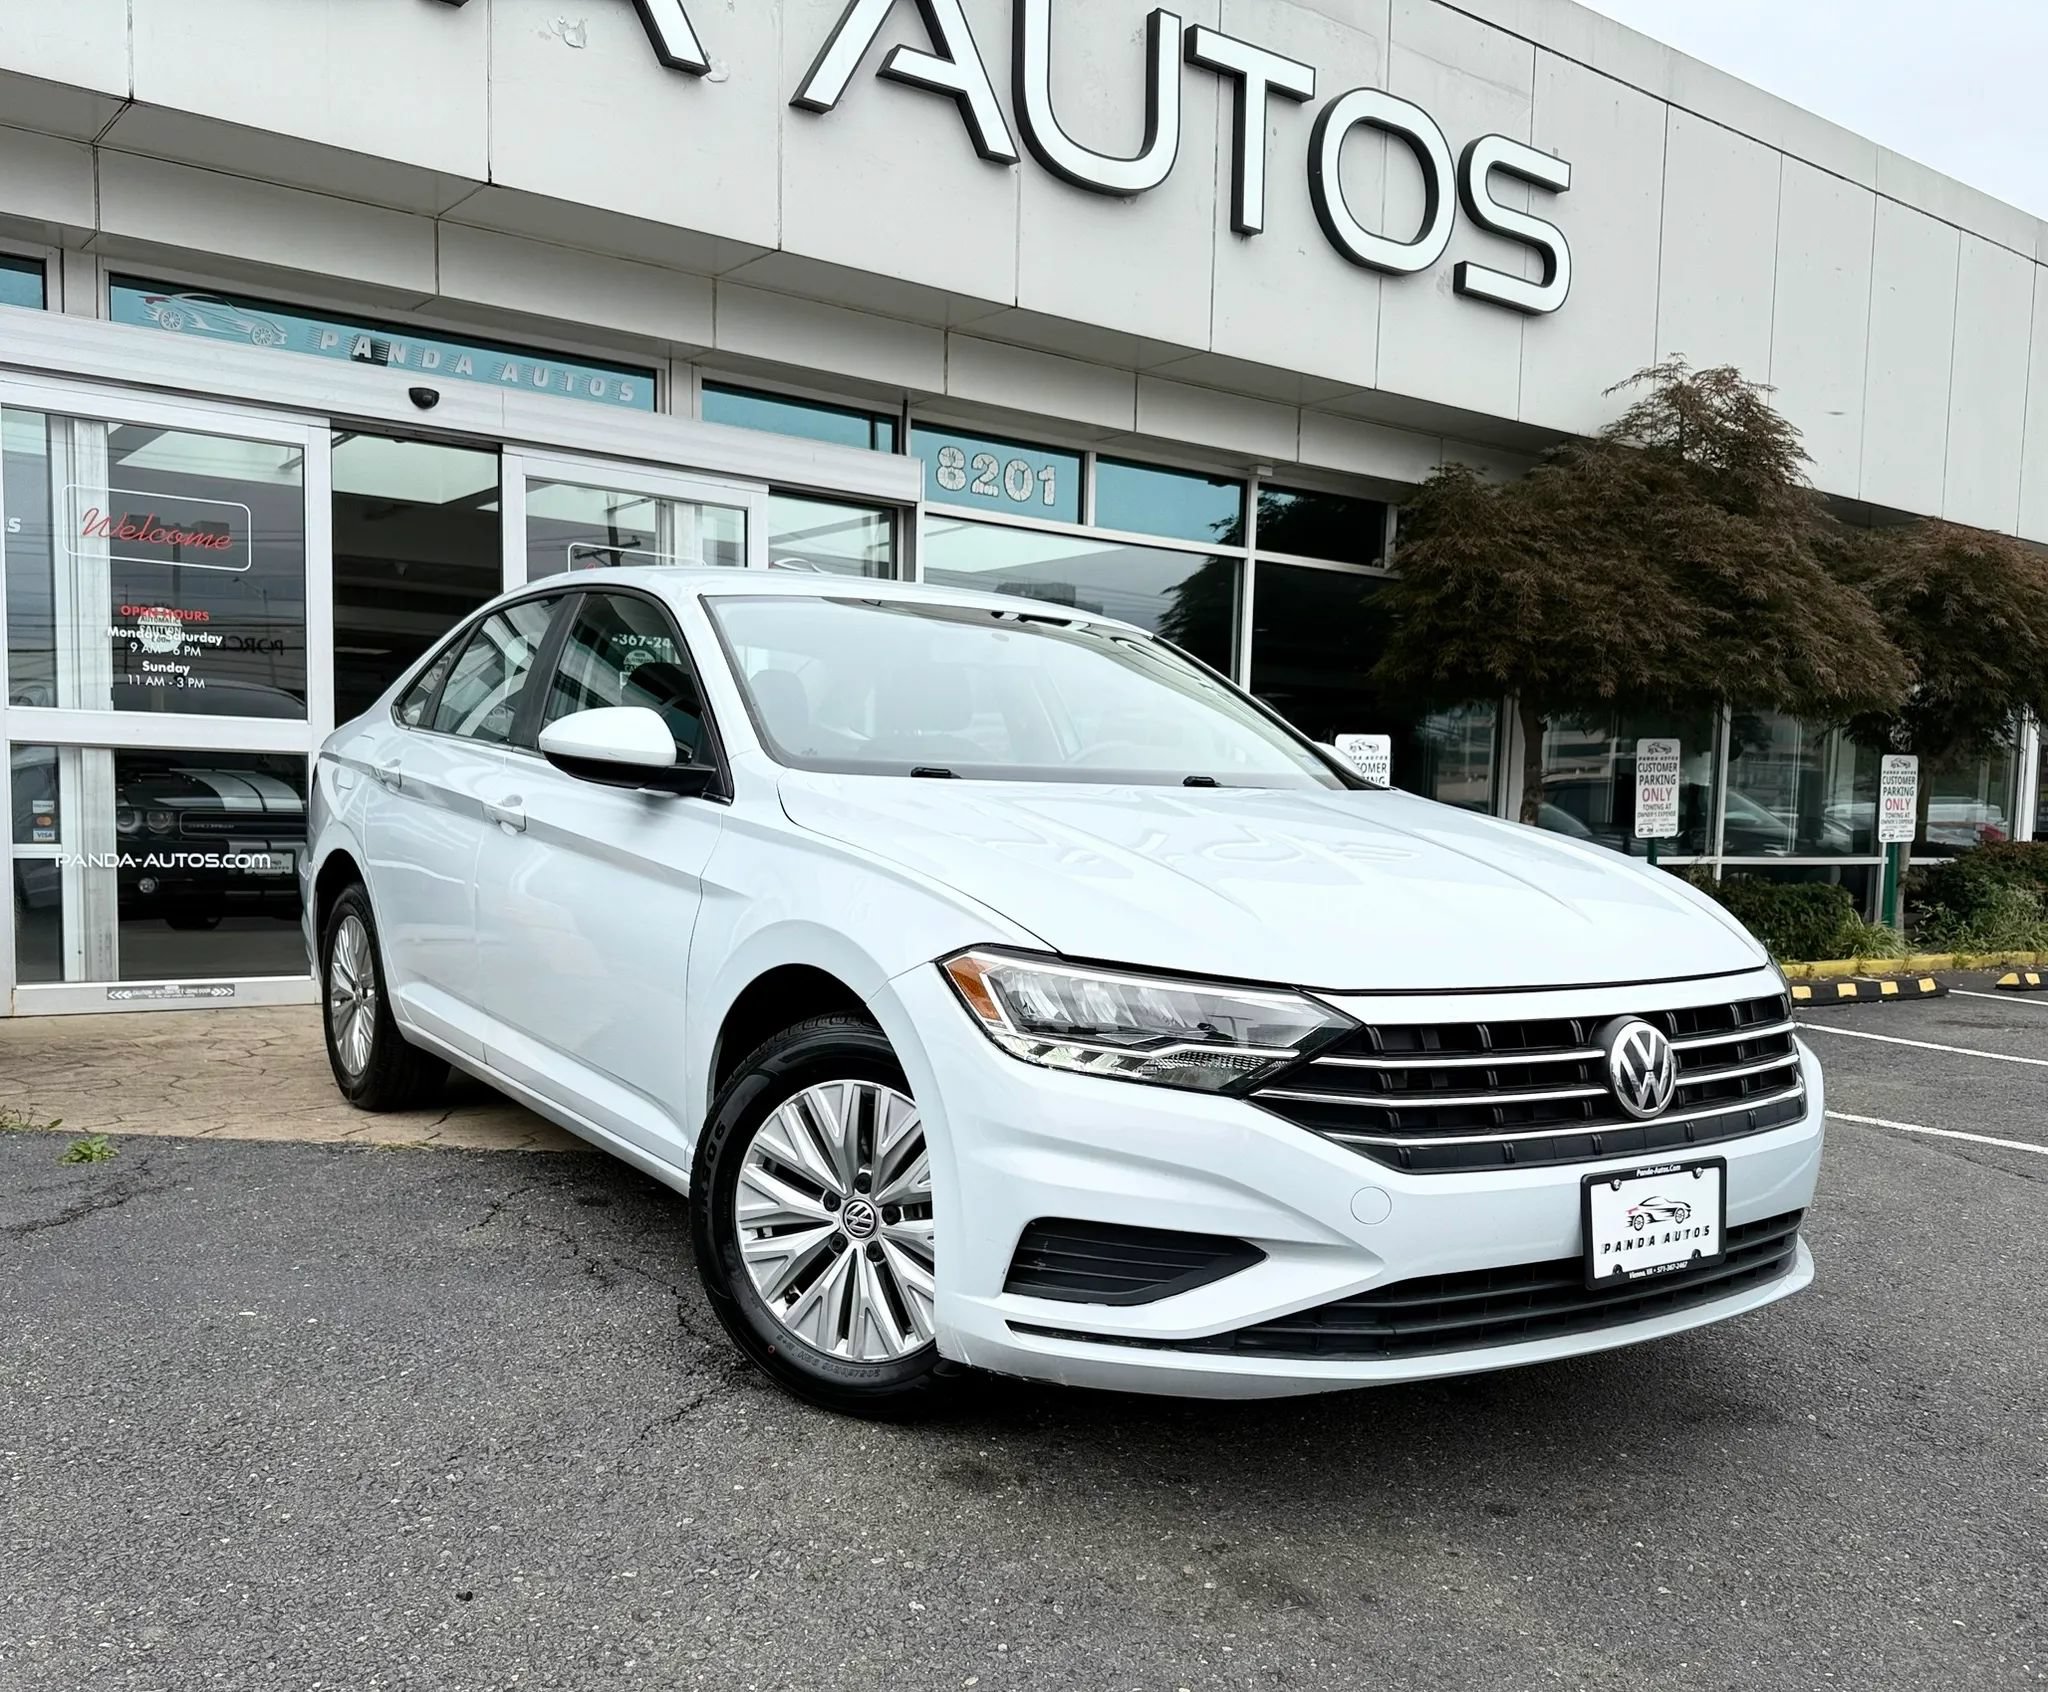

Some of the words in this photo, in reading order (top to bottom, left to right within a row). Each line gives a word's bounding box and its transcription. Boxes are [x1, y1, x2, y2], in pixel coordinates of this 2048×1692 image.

[788, 0, 1571, 315] AUTOS
[314, 328, 473, 376] PANDA
[497, 361, 635, 402] AUTOS
[936, 445, 1056, 506] 8201
[82, 507, 233, 550] Welcome
[130, 642, 138, 653] 9
[184, 645, 202, 657] PM
[142, 660, 191, 677] Sunday
[128, 675, 141, 686] 11
[146, 676, 165, 687] AM
[176, 677, 184, 688] 3
[188, 678, 206, 689] PM
[1357, 763, 1387, 774] OMER
[1637, 762, 1678, 773] CUSTOMER
[1639, 774, 1676, 785] PARKING
[1882, 776, 1916, 785] CUSTOMER
[1642, 787, 1673, 802] ONLY
[1883, 786, 1914, 796] PARKING
[1885, 798, 1911, 811] ONLY
[1603, 1235, 1656, 1255] PANDA
[1663, 1225, 1710, 1243] AUTOS
